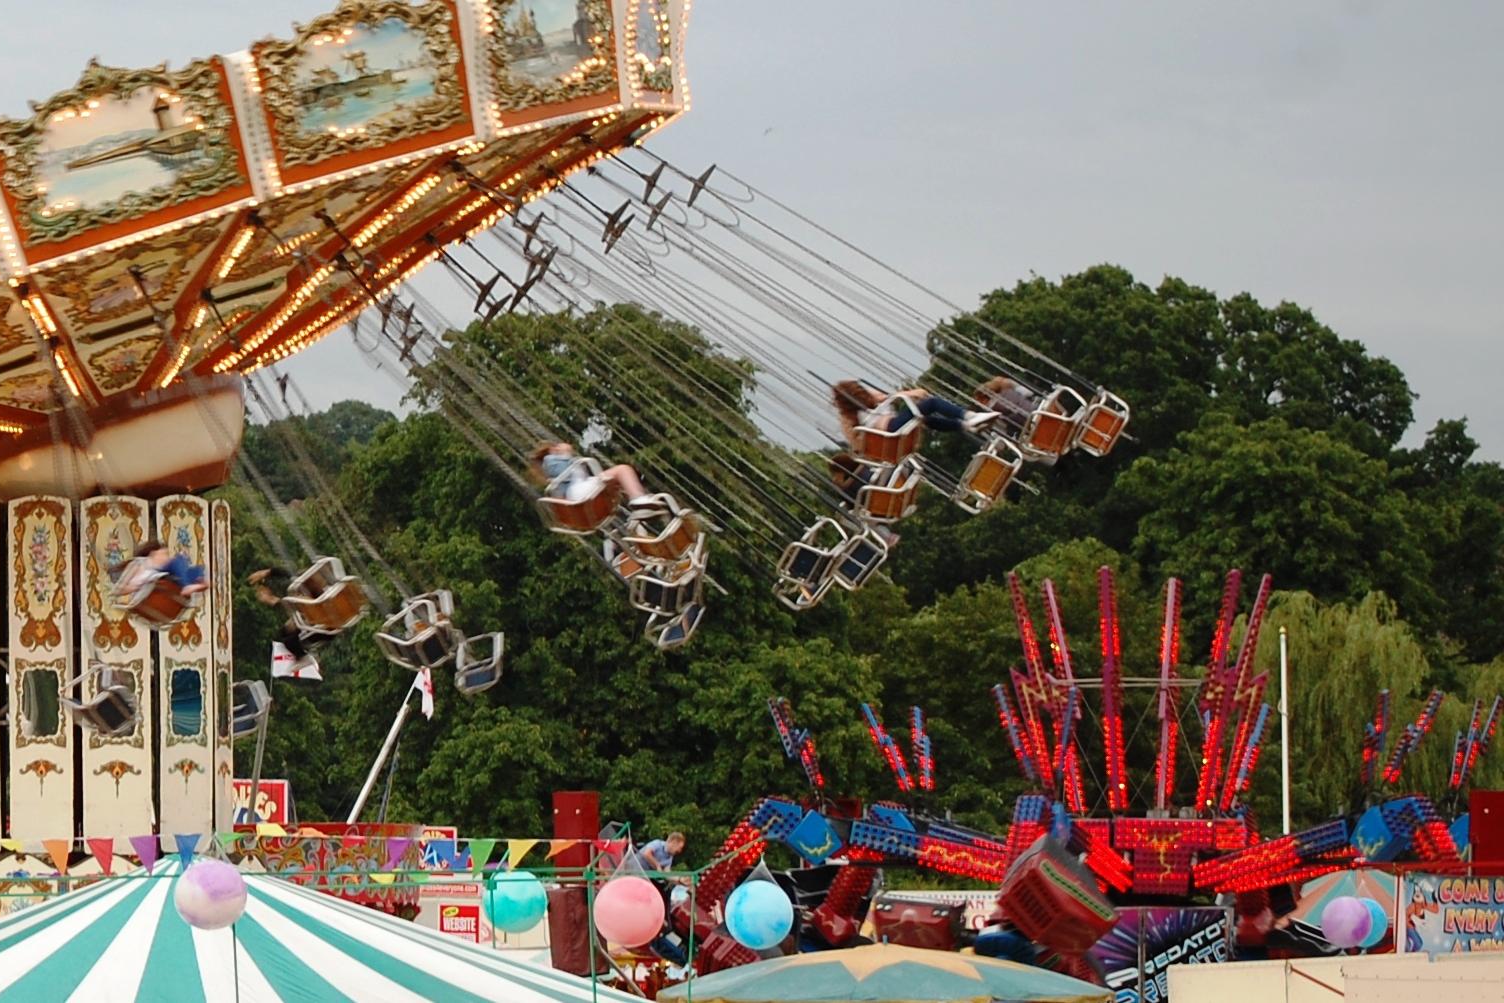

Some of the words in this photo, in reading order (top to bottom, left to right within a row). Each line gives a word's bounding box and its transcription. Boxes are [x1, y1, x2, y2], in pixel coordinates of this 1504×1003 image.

[1438, 879, 1489, 904] COME
[443, 917, 477, 932] WEBSITE
[1444, 908, 1499, 933] EVERY
